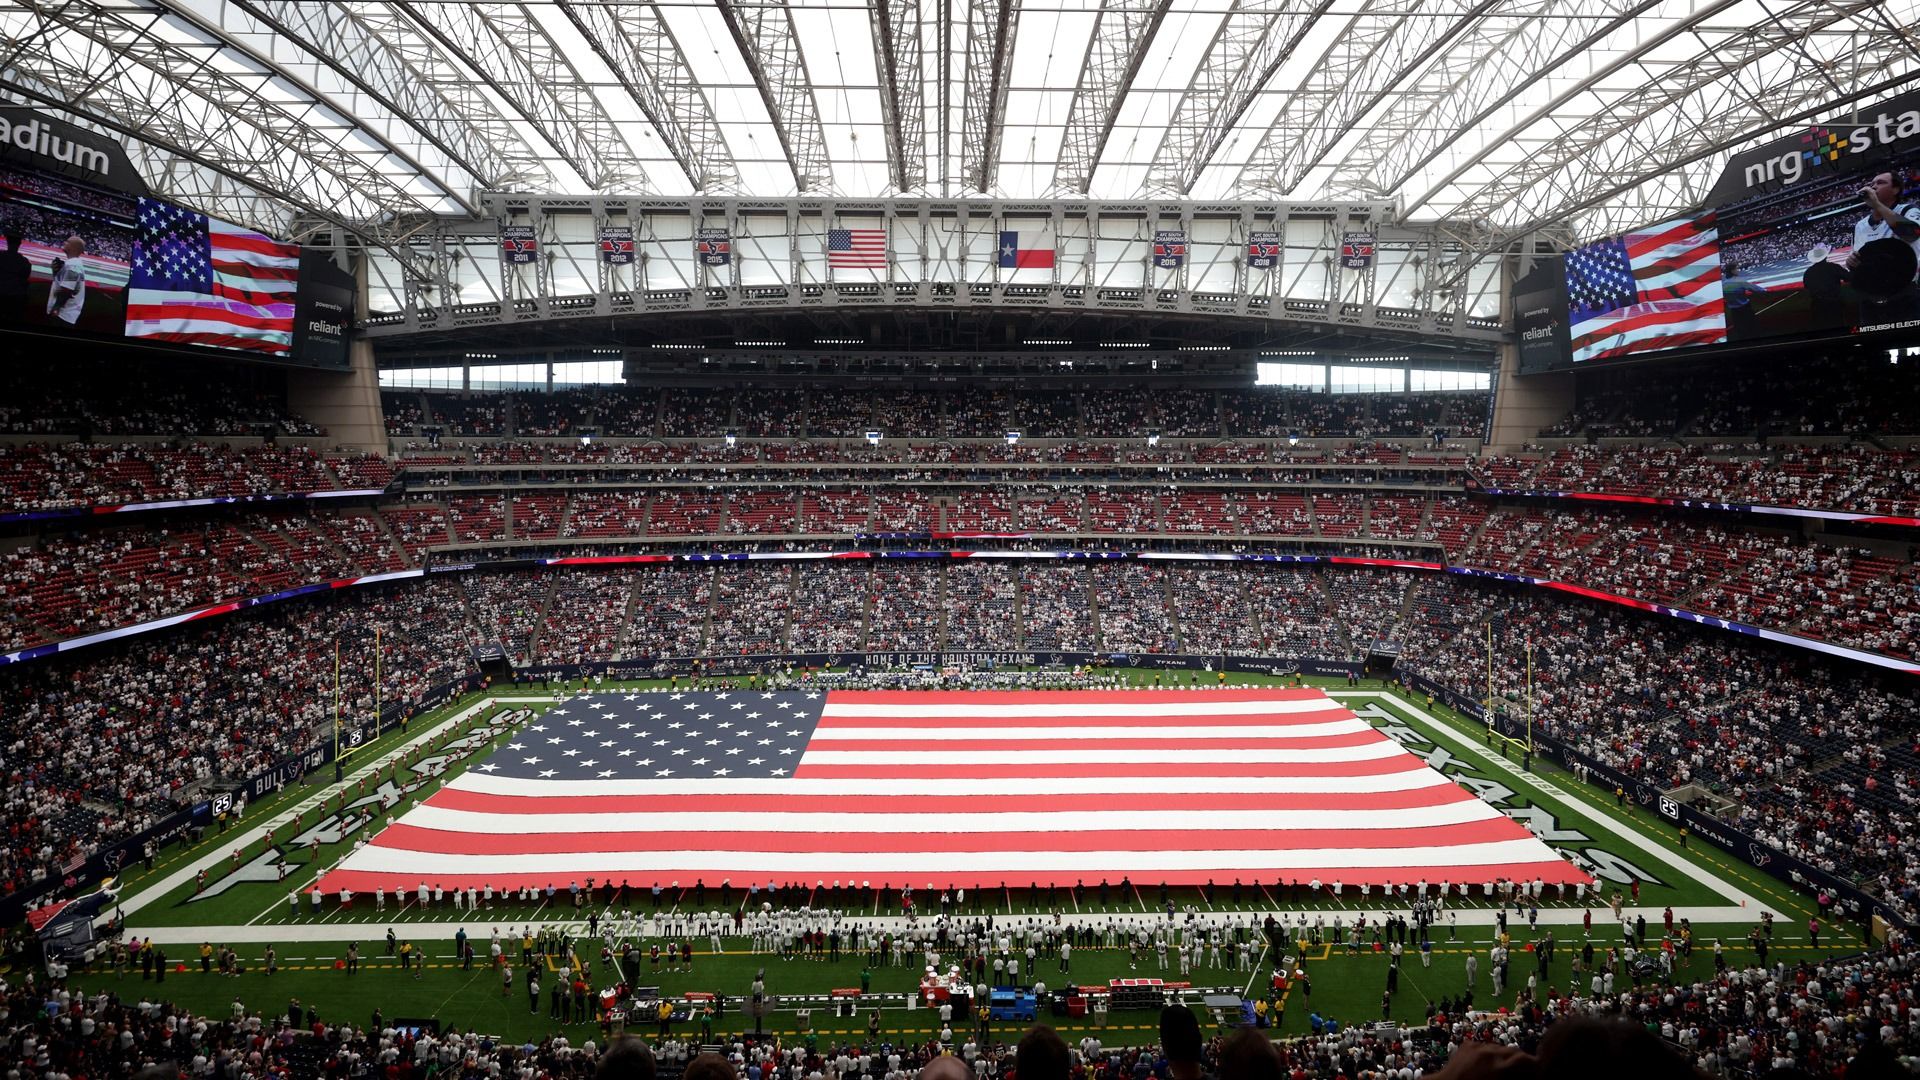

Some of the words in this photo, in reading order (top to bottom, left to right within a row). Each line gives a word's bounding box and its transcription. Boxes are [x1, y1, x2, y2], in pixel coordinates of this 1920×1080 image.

[1745, 151, 1803, 188] nrg
[309, 320, 341, 335] reliant
[1522, 325, 1553, 340] reliant
[1859, 323, 1895, 333] MITSUBISHI
[865, 653, 893, 665] HOME
[900, 654, 912, 664] OF
[917, 653, 936, 664] THE
[942, 652, 990, 666] HOUSTON
[996, 654, 1035, 664] TEXANS
[1459, 703, 1483, 719] TEXANS
[351, 732, 361, 744] 25
[256, 768, 286, 795] BULL
[303, 748, 324, 771] PEN
[1475, 748, 1507, 762] END
[1504, 763, 1566, 797] RACISM
[1588, 767, 1624, 789] TEXANS
[215, 796, 229, 813] 25
[1662, 799, 1676, 816] 25
[1686, 818, 1734, 848] TEXANS
